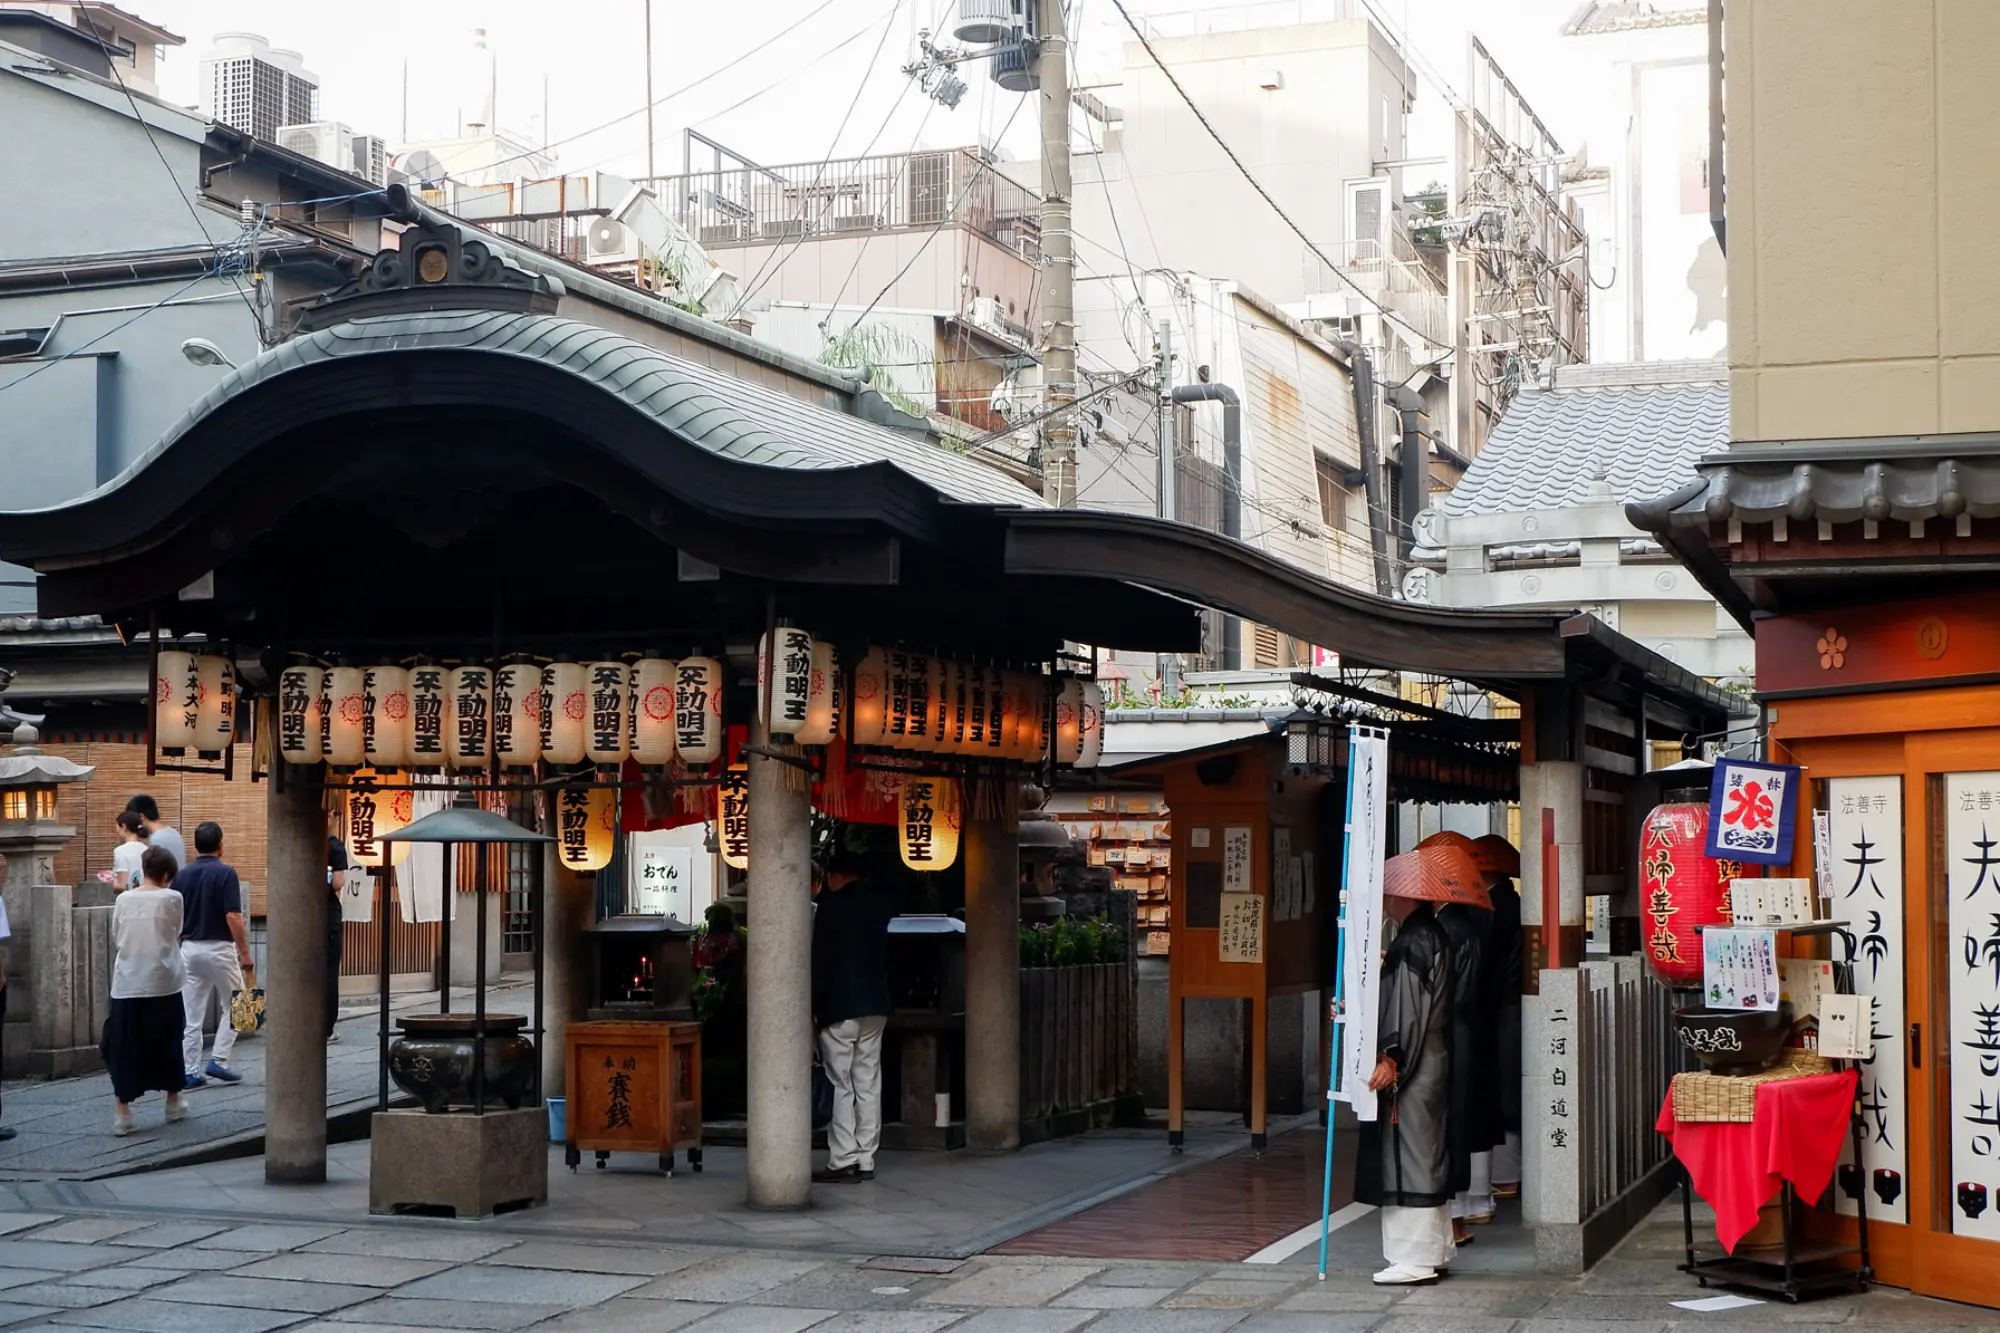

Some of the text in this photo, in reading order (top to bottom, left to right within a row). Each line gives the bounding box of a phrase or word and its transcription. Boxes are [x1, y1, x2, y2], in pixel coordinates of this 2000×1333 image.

[183, 656, 199, 730] 山本大河
[281, 671, 310, 751] 不動明王
[412, 671, 443, 753] 不動明王
[456, 671, 489, 757] 不動明王
[590, 666, 623, 752] 不動明王
[676, 666, 709, 748] 不動明王
[783, 631, 811, 721] 不動明王
[349, 776, 381, 857] 不動明王
[905, 782, 934, 861] 不動明王
[1841, 794, 1888, 815] 法善寺
[643, 863, 678, 879] おでん
[1646, 813, 1685, 964] 夫婦善哉
[605, 1071, 633, 1129] 賽銭
[1550, 1008, 1569, 1149] 二河白道堂
